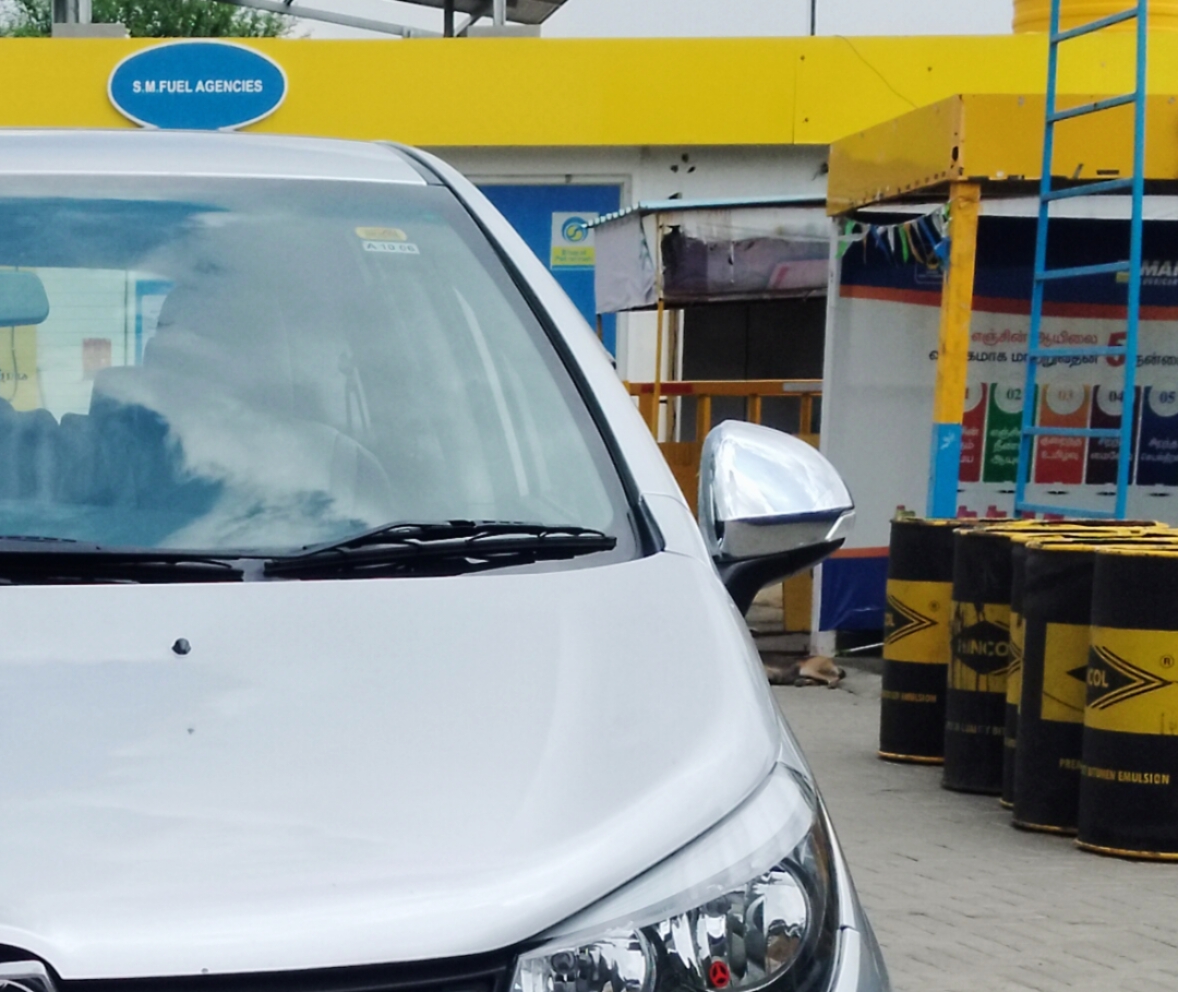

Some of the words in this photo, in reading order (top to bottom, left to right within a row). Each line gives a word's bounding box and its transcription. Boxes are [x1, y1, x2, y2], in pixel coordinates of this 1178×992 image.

[195, 79, 263, 93] AGENCIES
[1006, 388, 1022, 400] 02
[1159, 391, 1175, 403] 05
[1118, 770, 1170, 785] EMULSION
